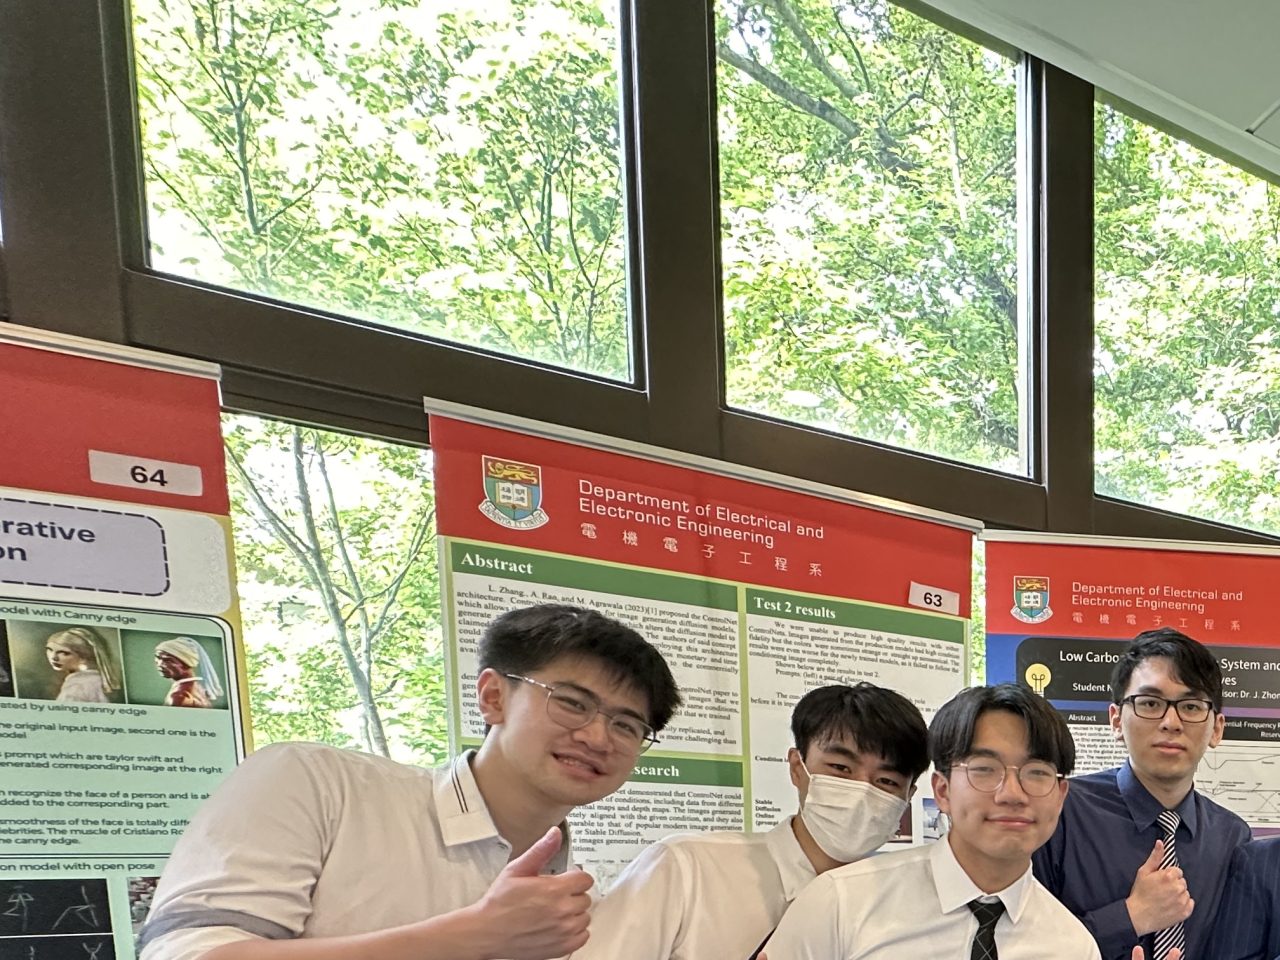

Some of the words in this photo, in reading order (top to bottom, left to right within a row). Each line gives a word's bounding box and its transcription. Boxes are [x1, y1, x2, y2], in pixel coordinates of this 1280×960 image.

[130, 465, 168, 487] 64
[579, 479, 690, 513] Department
[695, 505, 711, 517] of
[716, 506, 791, 533] Electrical
[796, 524, 824, 539] and
[579, 498, 671, 527] Electronic
[677, 516, 774, 549] Engineering
[2, 519, 96, 543] rative
[461, 552, 533, 574] Abstract
[1072, 582, 1145, 596] Department
[1149, 586, 1160, 596] of
[1164, 586, 1218, 600] Electrical
[1221, 591, 1243, 601] and
[457, 600, 482, 608] which
[484, 603, 509, 611] allows
[923, 592, 943, 607] 63
[1072, 595, 1132, 608] Electronic
[1136, 597, 1205, 614] Engineering
[458, 610, 492, 619] generate
[589, 599, 623, 610] Agrawala
[659, 609, 689, 620] proposed
[691, 612, 701, 620] the
[754, 596, 786, 611] Test
[784, 602, 792, 613] 2
[796, 605, 836, 619] results
[33, 608, 61, 617] with
[64, 610, 103, 622] Canny
[106, 613, 137, 624] edge
[459, 628, 481, 636] could
[1059, 650, 1083, 662] Low
[1085, 651, 1120, 663] Carbo
[1221, 658, 1260, 671] System
[1072, 682, 1106, 692] Student
[1240, 690, 1250, 698] Dr.
[1253, 691, 1260, 699] J.
[30, 702, 44, 712] by
[48, 704, 79, 713] using
[82, 706, 116, 715] canny
[119, 707, 147, 716] edge
[1244, 721, 1276, 730] Frequency
[4, 751, 47, 761] prompt
[49, 751, 84, 760] which
[105, 753, 134, 763] taylor
[137, 754, 162, 763] swift
[164, 755, 184, 763] and
[52, 762, 130, 773] corresponding
[132, 763, 165, 773] image
[179, 765, 197, 773] the
[199, 766, 223, 774] right
[632, 765, 680, 777] search
[8, 790, 62, 799] recognize
[64, 790, 82, 798] the
[85, 790, 107, 798] face
[109, 790, 121, 799] of
[131, 792, 167, 801] person
[168, 791, 188, 799] and
[190, 791, 199, 800] is
[46, 799, 65, 807] the
[67, 800, 144, 810] corresponding
[68, 818, 80, 826] of
[81, 818, 99, 826] the
[101, 818, 124, 826] face
[136, 818, 168, 828] totally
[70, 828, 109, 836] muscle
[111, 828, 122, 836] of
[123, 828, 169, 836] Cristiano
[585, 828, 607, 836] Stable
[19, 862, 60, 871] model
[63, 862, 91, 870] with
[94, 863, 125, 872] open
[128, 863, 155, 872] pose
